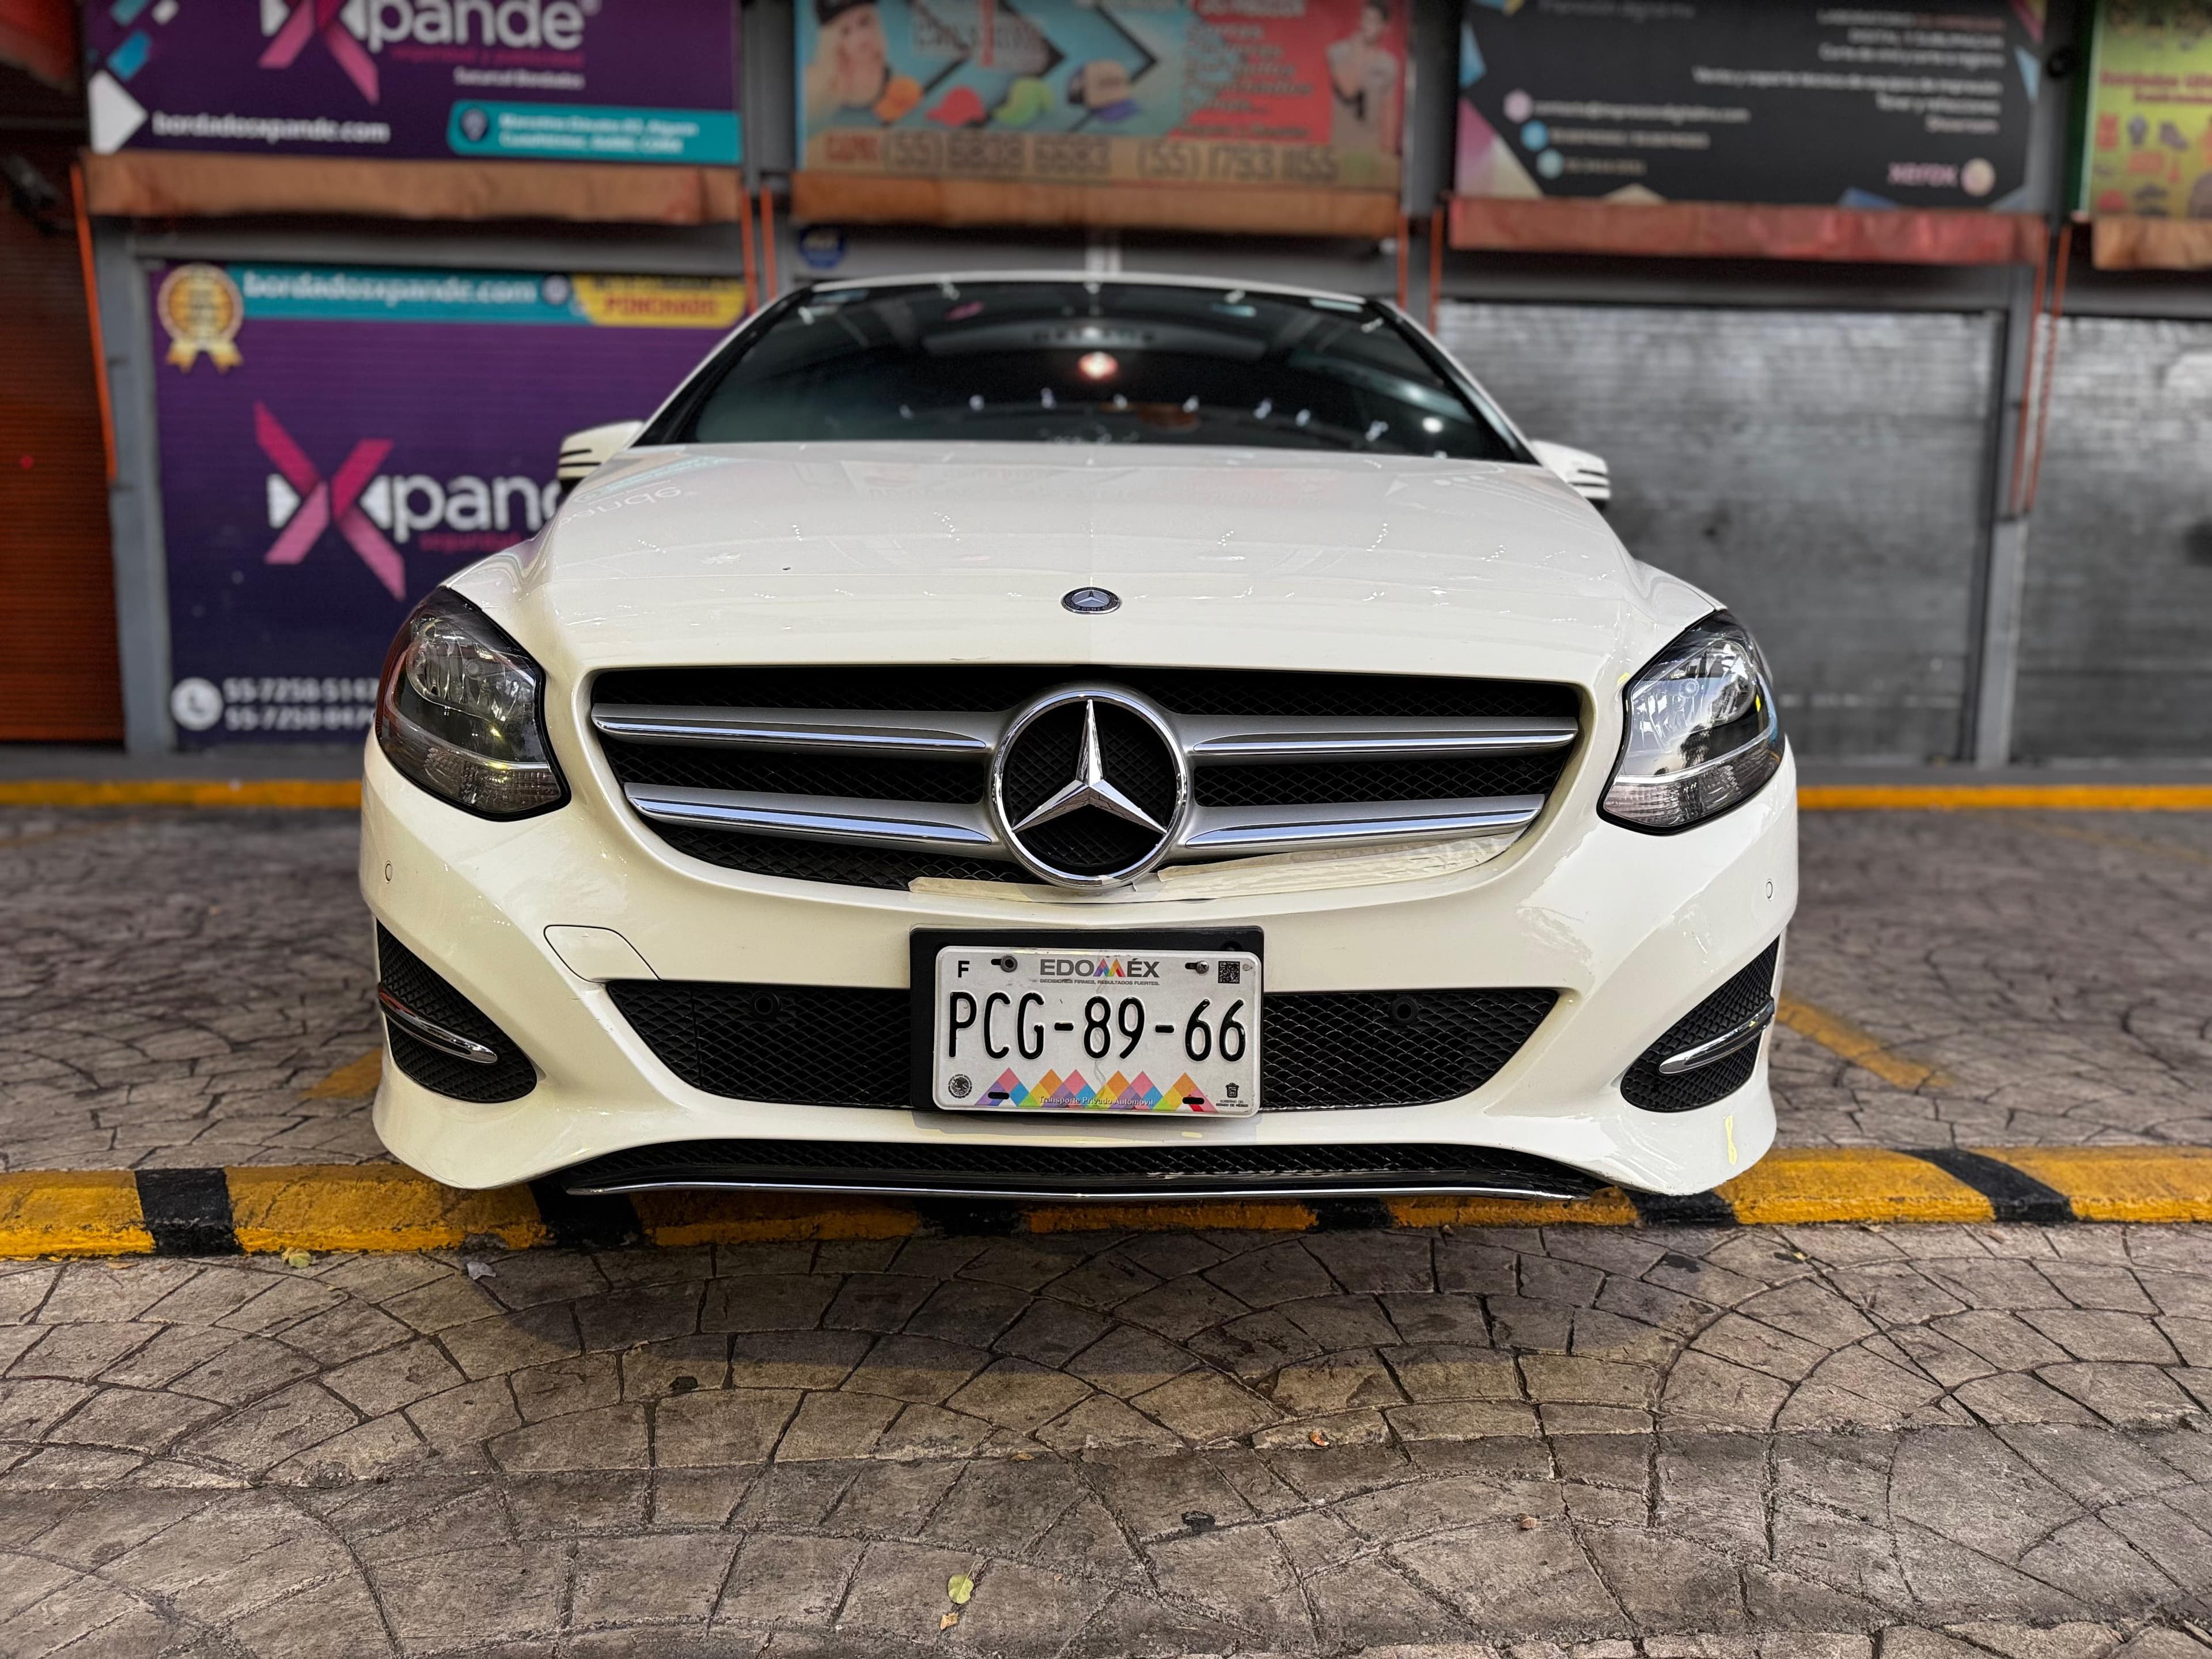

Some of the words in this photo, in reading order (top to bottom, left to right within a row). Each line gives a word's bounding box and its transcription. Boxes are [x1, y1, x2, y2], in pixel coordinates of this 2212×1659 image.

[958, 960, 970, 978] F
[1040, 957, 1160, 978] EDOMÉX
[948, 991, 1246, 1062] PCG-89-66
[1039, 1096, 1081, 1105] Transporte
[1082, 1096, 1112, 1105] Privado
[1112, 1097, 1154, 1106] Automóvil
